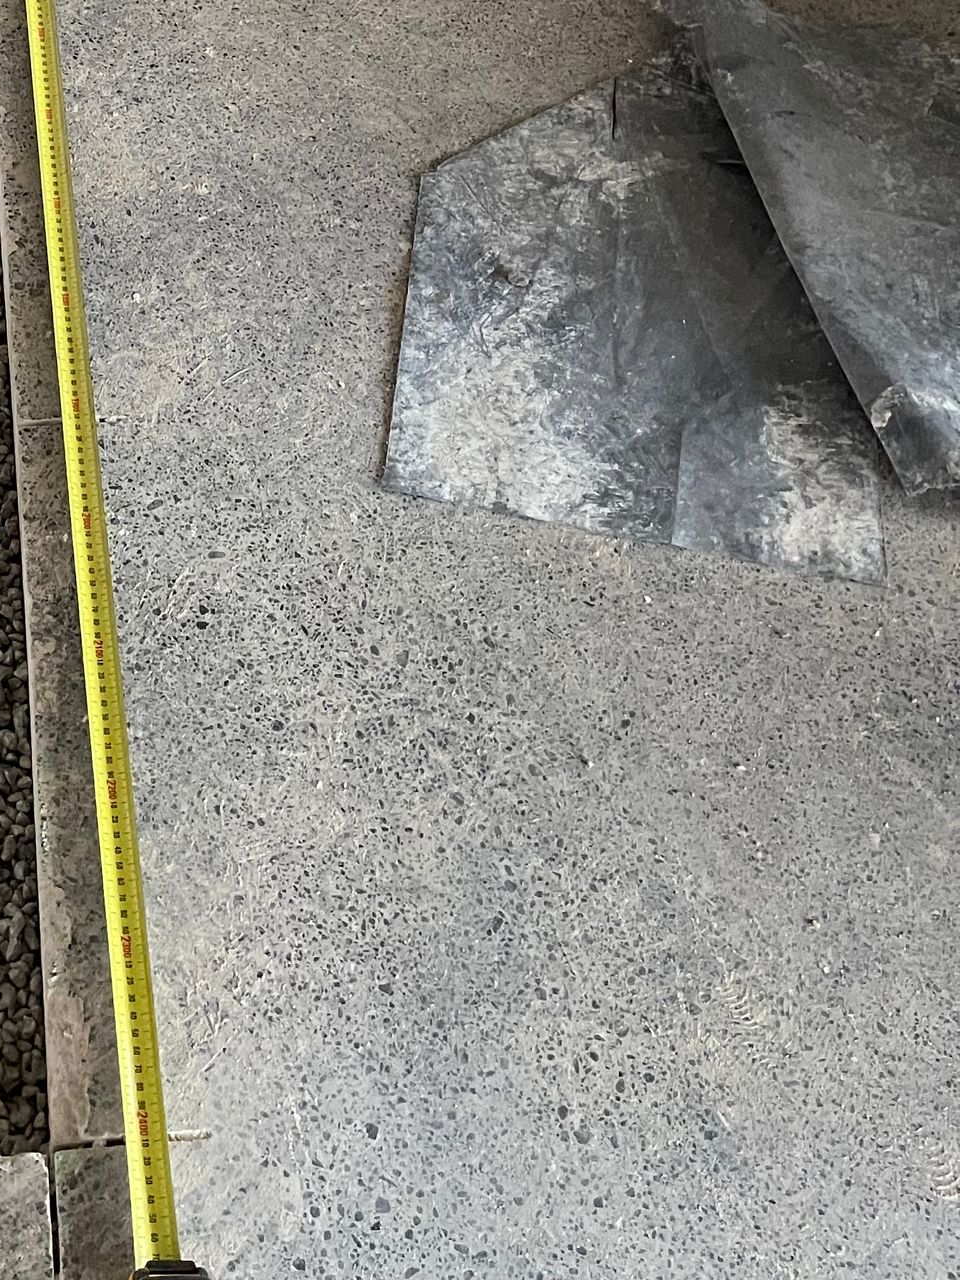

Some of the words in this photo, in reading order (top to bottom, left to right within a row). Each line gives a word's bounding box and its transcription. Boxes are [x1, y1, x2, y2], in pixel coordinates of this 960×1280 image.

[93, 640, 104, 658] 2100
[106, 780, 118, 800] 2200
[121, 935, 133, 958] 2300
[125, 960, 133, 968] 10
[127, 976, 134, 985] 20
[128, 993, 136, 1002] 30
[130, 1011, 138, 1020] 40
[132, 1028, 139, 1037] 50
[133, 1046, 141, 1055] 60
[135, 1064, 143, 1073] 70
[137, 1082, 144, 1091] 80
[138, 1100, 146, 1110] 90
[137, 1111, 150, 1136] 2400
[142, 1138, 150, 1148] 10
[144, 1156, 152, 1166] 20
[146, 1175, 153, 1185] 30
[147, 1194, 155, 1204] 40
[149, 1214, 157, 1223] 50
[151, 1232, 159, 1242] 60
